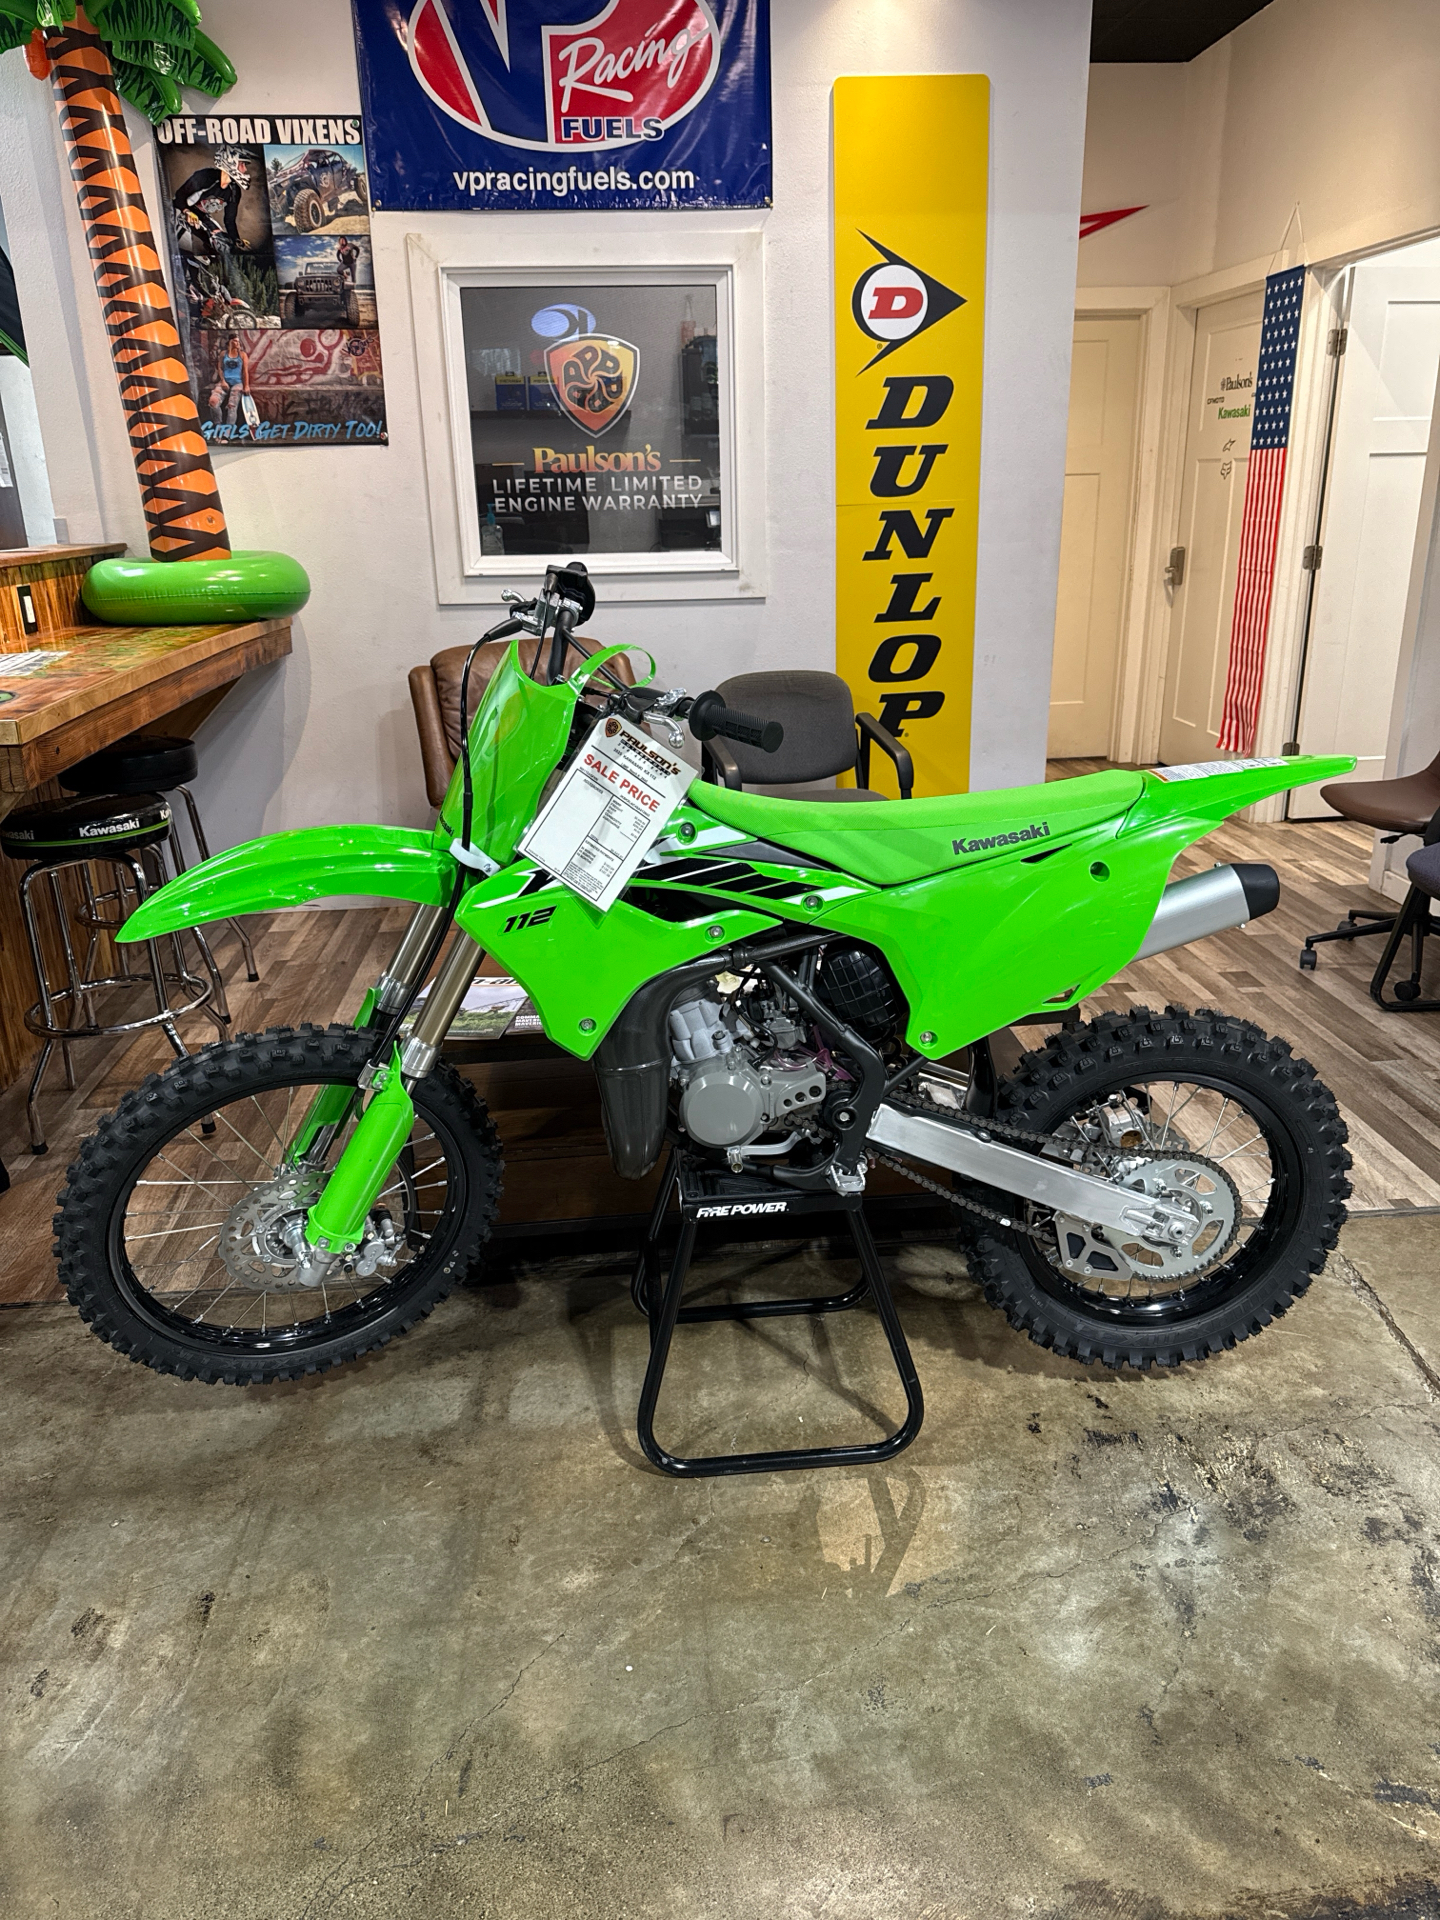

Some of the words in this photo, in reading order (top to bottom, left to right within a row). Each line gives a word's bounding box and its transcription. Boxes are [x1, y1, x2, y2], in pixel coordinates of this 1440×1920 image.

[558, 23, 706, 113] Racing
[157, 118, 271, 144] OFF-ROAD
[274, 118, 361, 144] VIXENS
[561, 116, 665, 141] FUELS
[453, 167, 695, 197] vpracingfuels.com
[868, 287, 923, 319] D
[1217, 404, 1251, 419] Kawasaki
[293, 421, 341, 440] DIRTY
[533, 444, 661, 474] Paulson's
[493, 476, 597, 494] LIFETIME
[611, 475, 702, 492] LIMITED
[495, 496, 576, 513] ENGINE
[582, 494, 702, 511] WARRANTY
[862, 375, 955, 738] DUNLOP
[583, 753, 619, 784] SALE
[619, 778, 661, 812] PRICE
[79, 818, 141, 838] Kawasaki
[952, 821, 1051, 855] Kawasaki
[503, 904, 557, 934] 112
